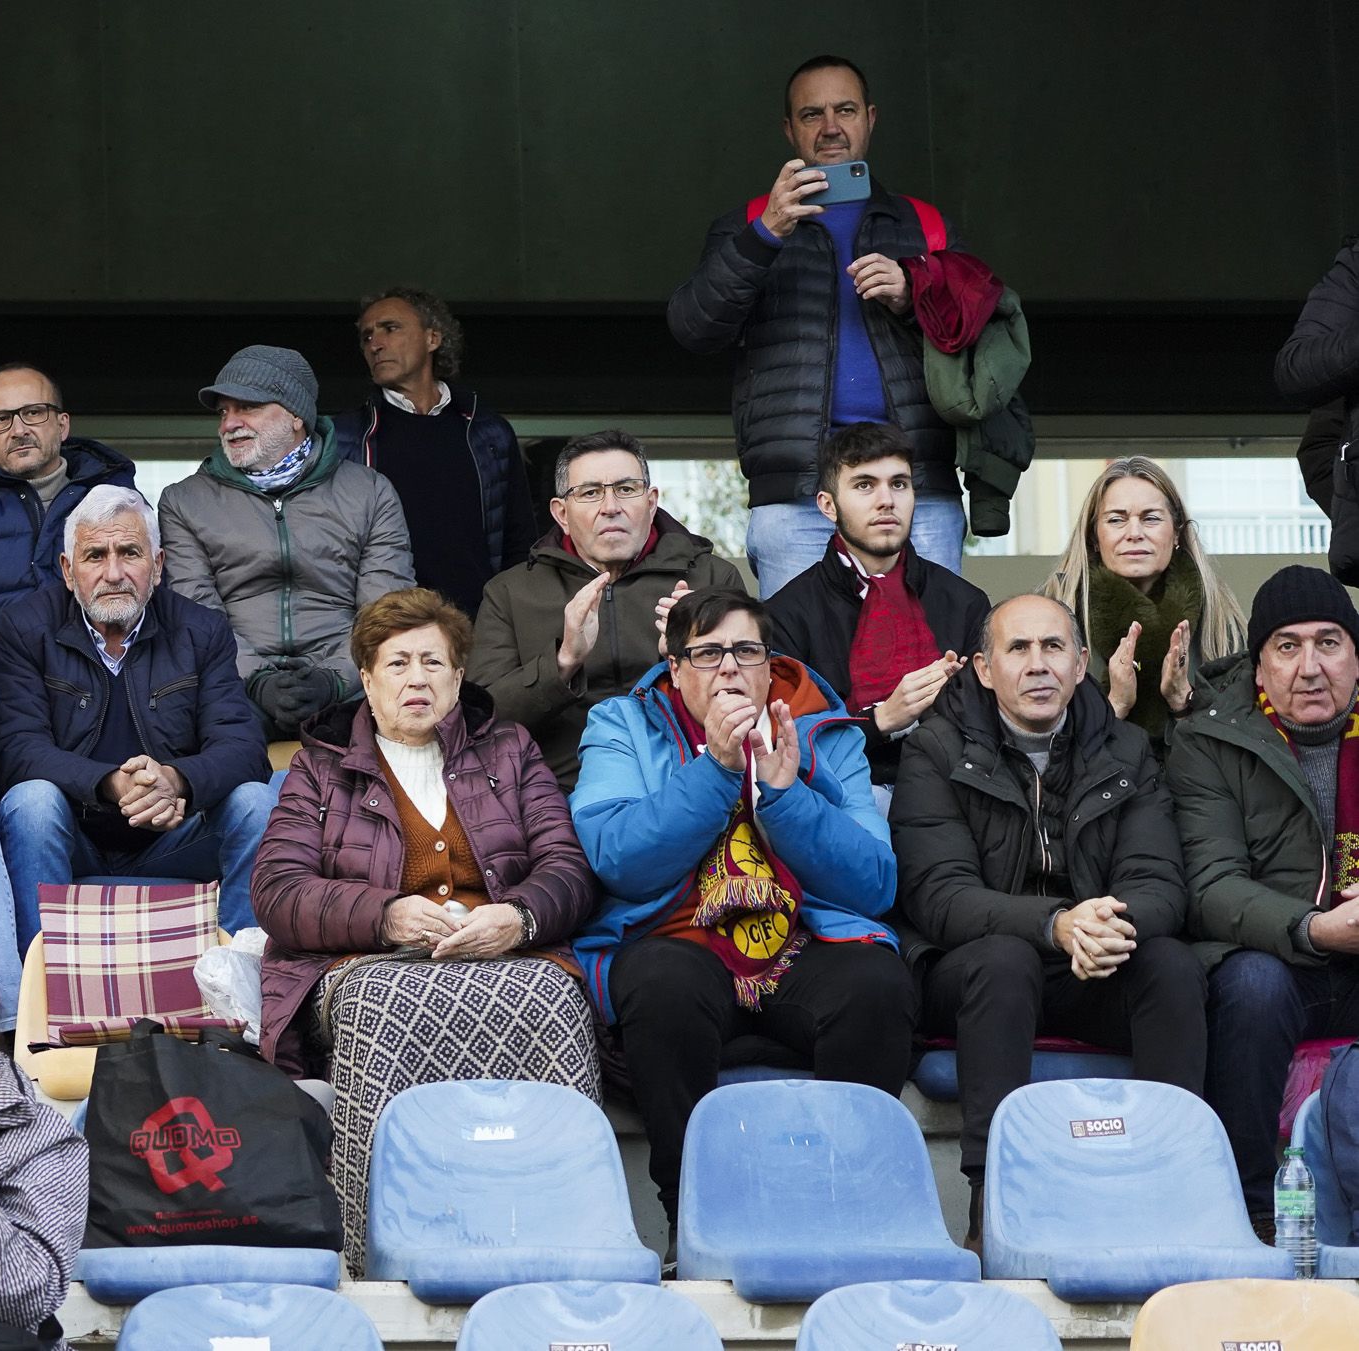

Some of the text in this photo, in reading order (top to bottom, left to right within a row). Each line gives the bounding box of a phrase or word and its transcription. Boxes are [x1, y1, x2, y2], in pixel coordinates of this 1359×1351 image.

[1086, 1119, 1122, 1132] SOCIO
[130, 1124, 242, 1158] QUOMO
[126, 1215, 259, 1237] www.quomoshop.es
[1240, 1342, 1279, 1351] SOCIO
